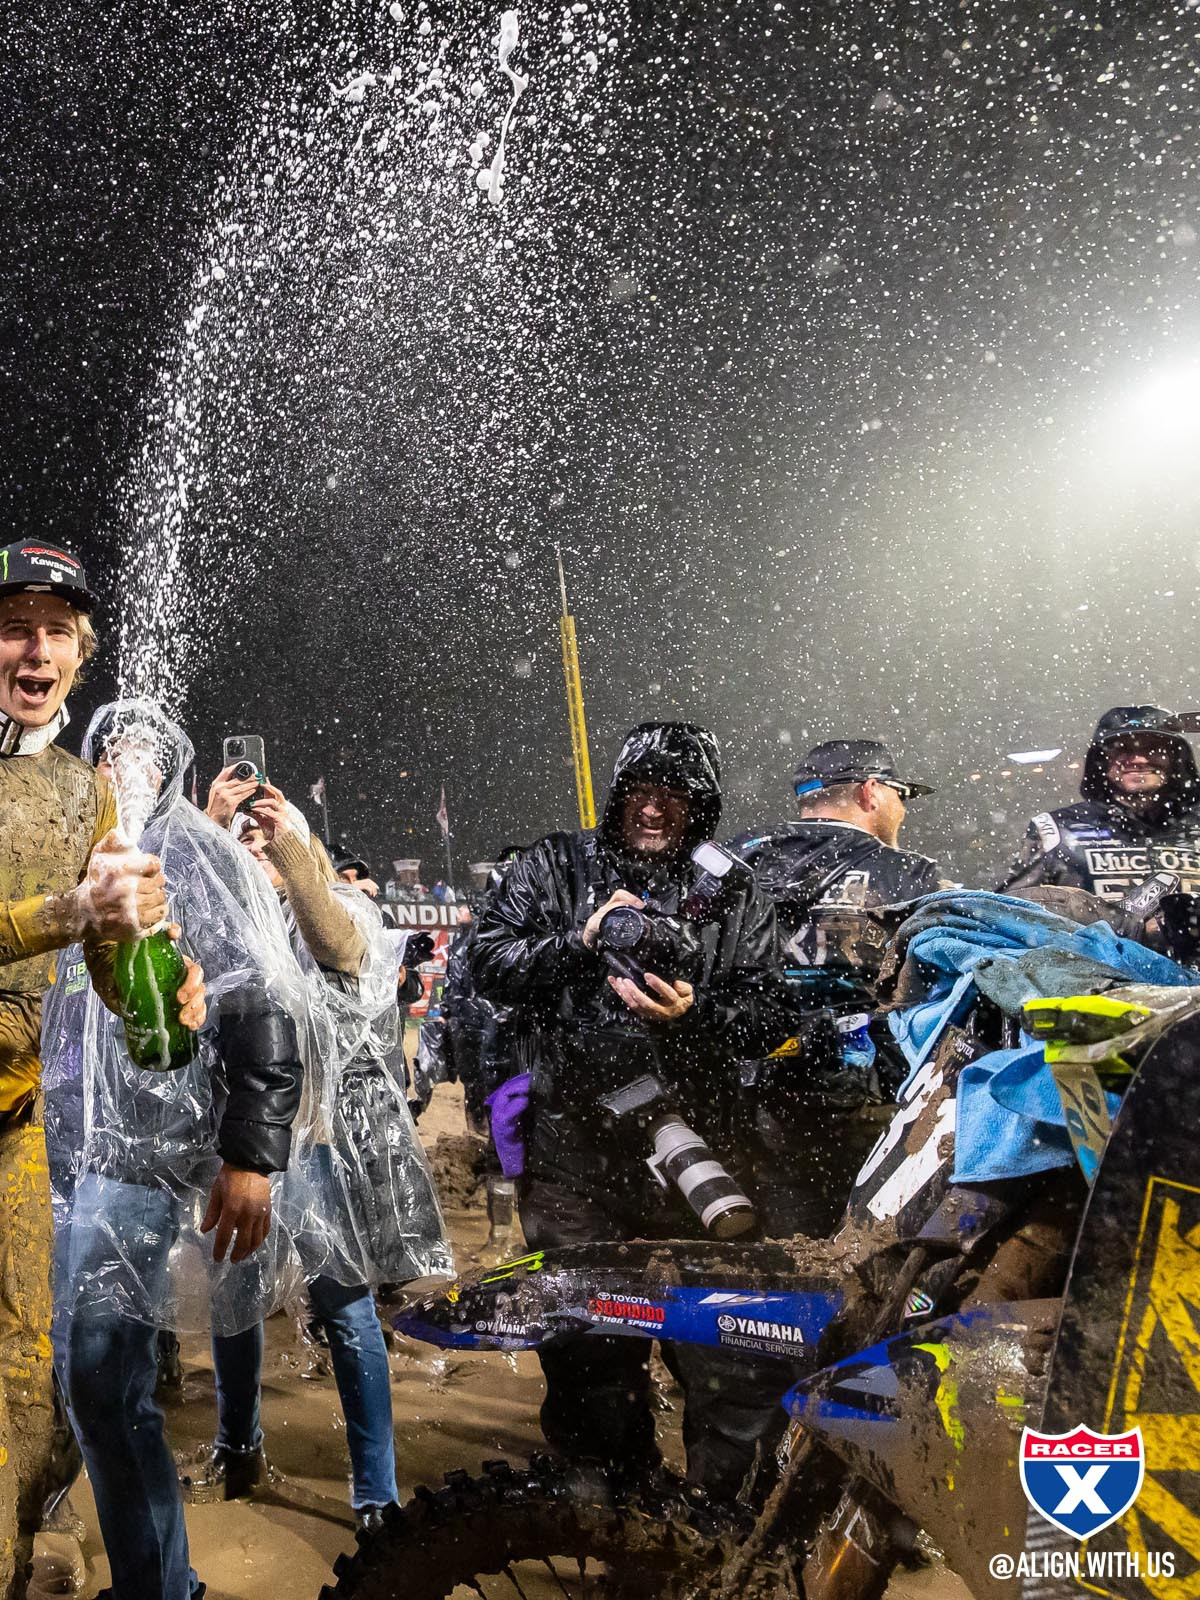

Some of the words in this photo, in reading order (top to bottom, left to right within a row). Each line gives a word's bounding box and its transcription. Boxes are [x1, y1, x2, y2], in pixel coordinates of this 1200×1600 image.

[30, 556, 77, 578] Kawasaki
[612, 1293, 651, 1306] TOYOTA
[487, 1321, 527, 1336] YAMAHA
[591, 1313, 625, 1325] ATION
[626, 1319, 664, 1331] SPORTS
[736, 1317, 804, 1343] YAMAHA
[720, 1334, 764, 1351] FINANCIAL
[765, 1342, 805, 1358] SERVICES
